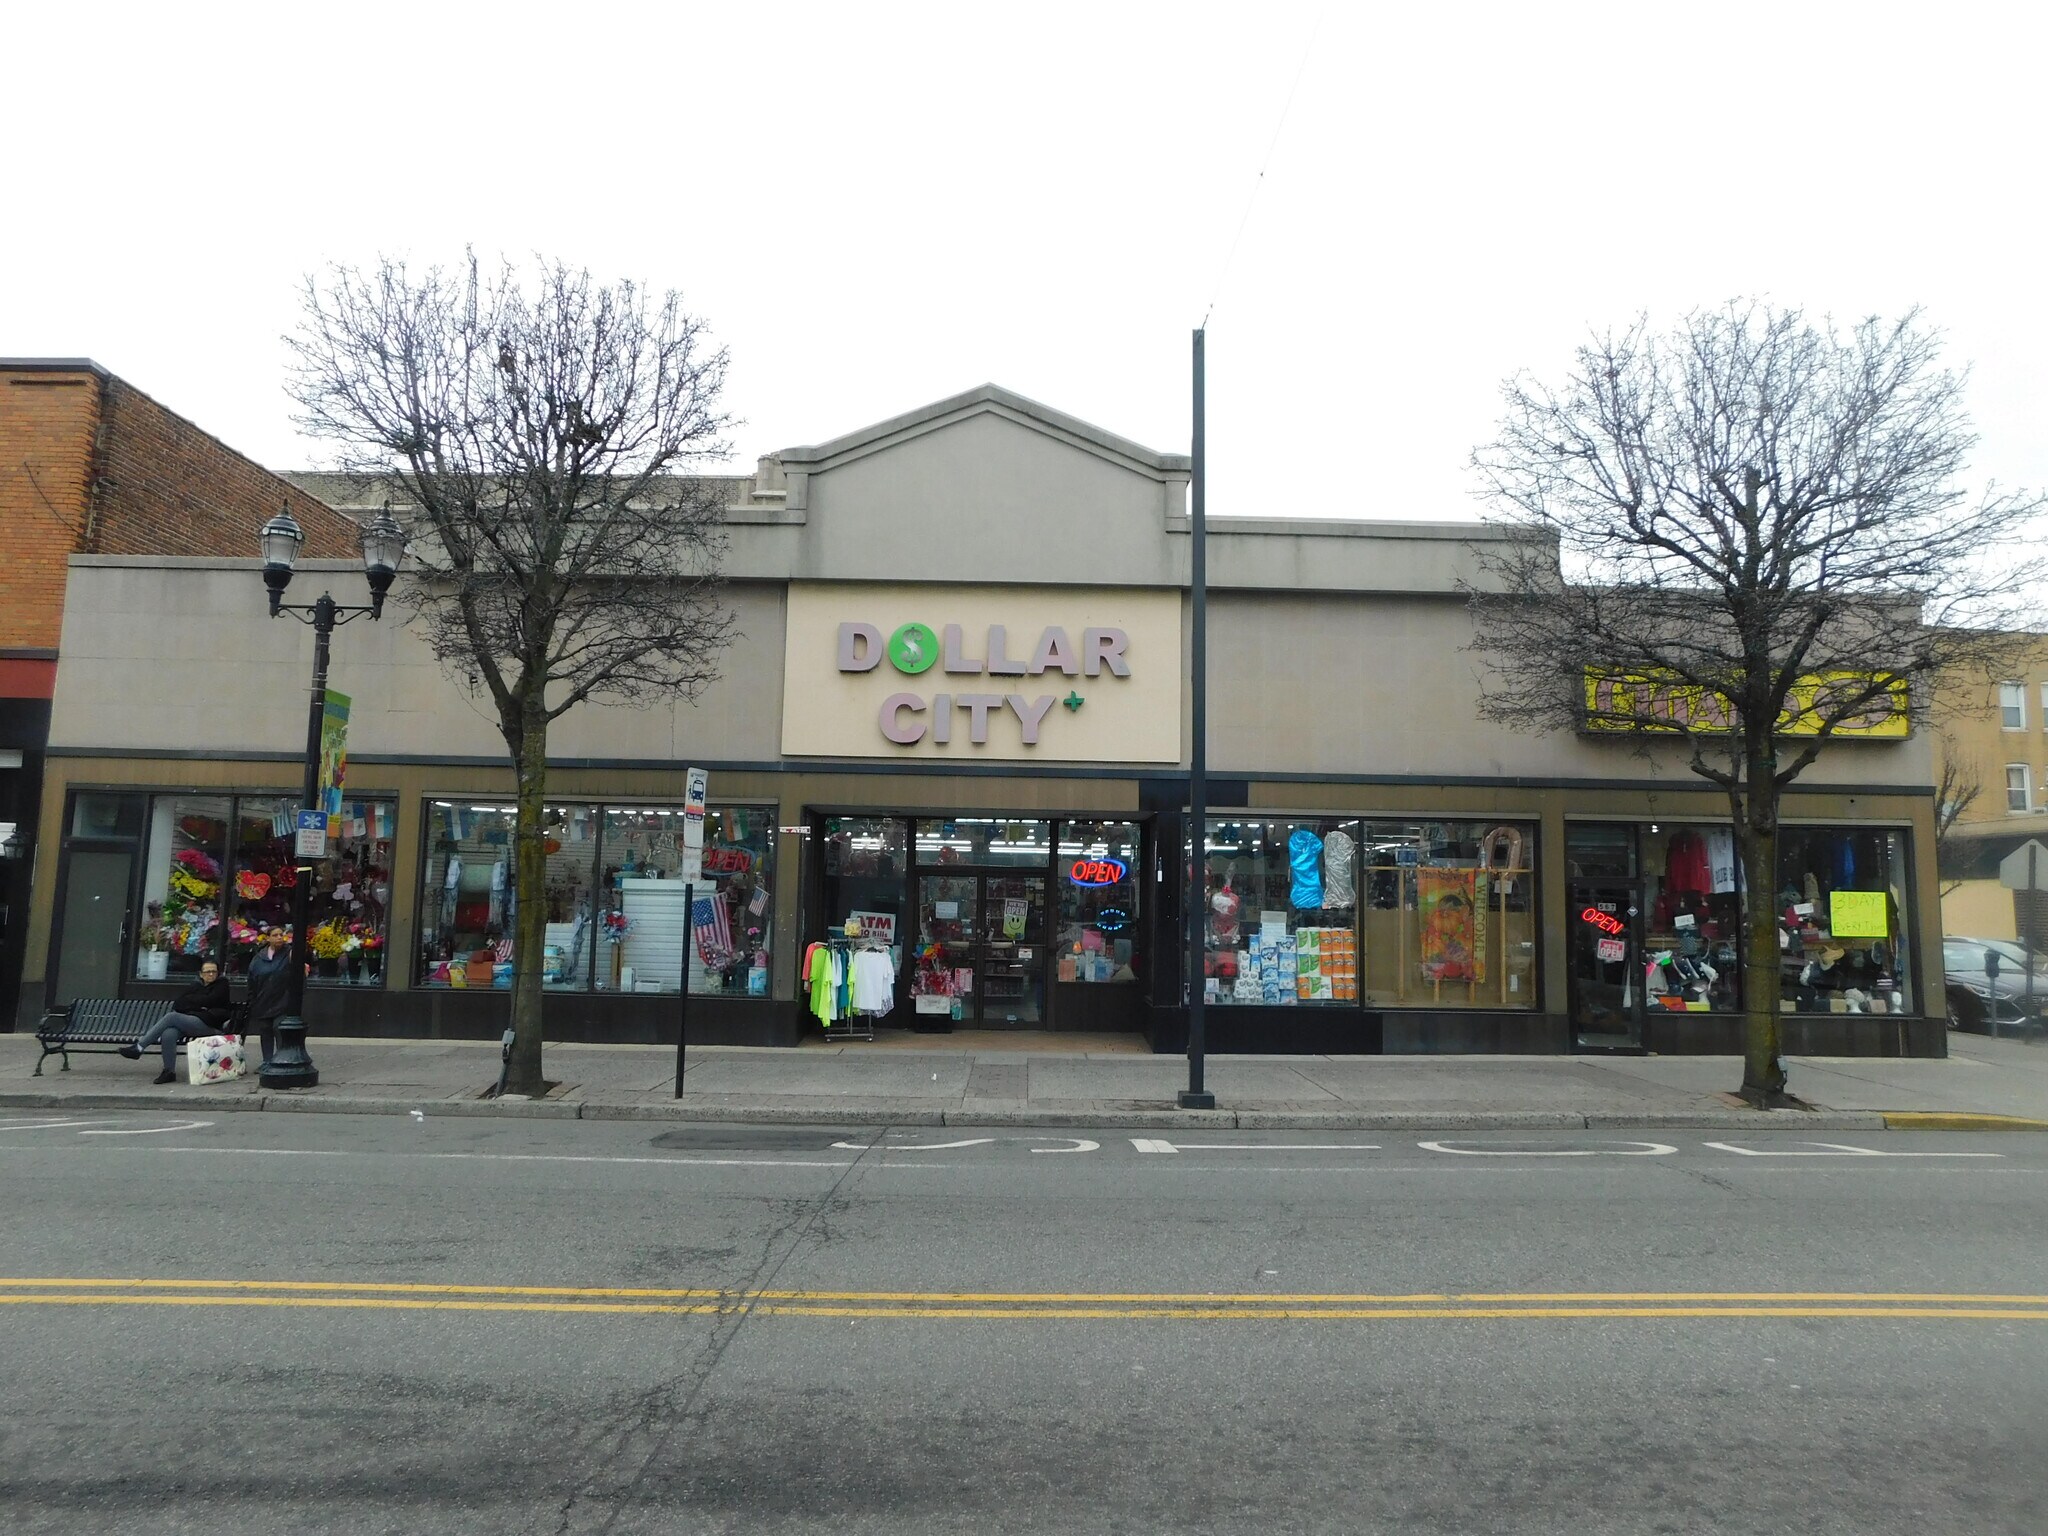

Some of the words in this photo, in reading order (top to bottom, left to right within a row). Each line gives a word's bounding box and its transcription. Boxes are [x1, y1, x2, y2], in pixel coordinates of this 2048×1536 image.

[1071, 860, 1121, 883] OPEN
[1007, 906, 1026, 916] OPEN
[1475, 884, 1486, 952] WELCOME
[1583, 908, 1624, 934] OPEN
[1601, 947, 1623, 958] OPEN
